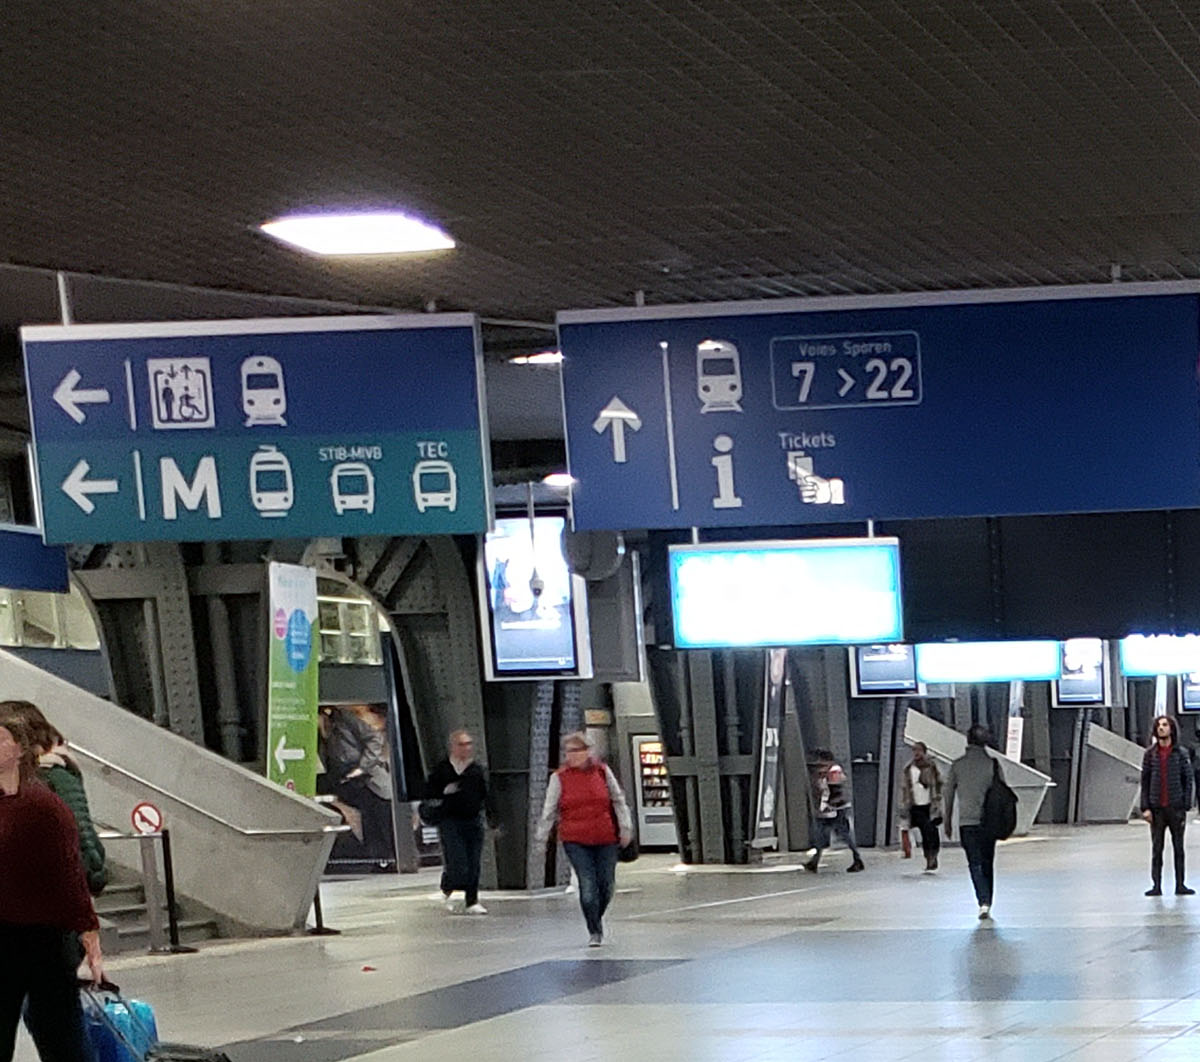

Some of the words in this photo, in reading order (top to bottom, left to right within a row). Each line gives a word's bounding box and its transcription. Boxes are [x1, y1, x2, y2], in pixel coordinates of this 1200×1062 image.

[799, 343, 837, 358] Voies
[791, 361, 815, 402] 7
[865, 357, 914, 399] 22
[416, 441, 449, 458] TEC
[777, 431, 837, 450] Tickets
[318, 446, 383, 462] STIB-MIVB
[160, 455, 222, 521] M
